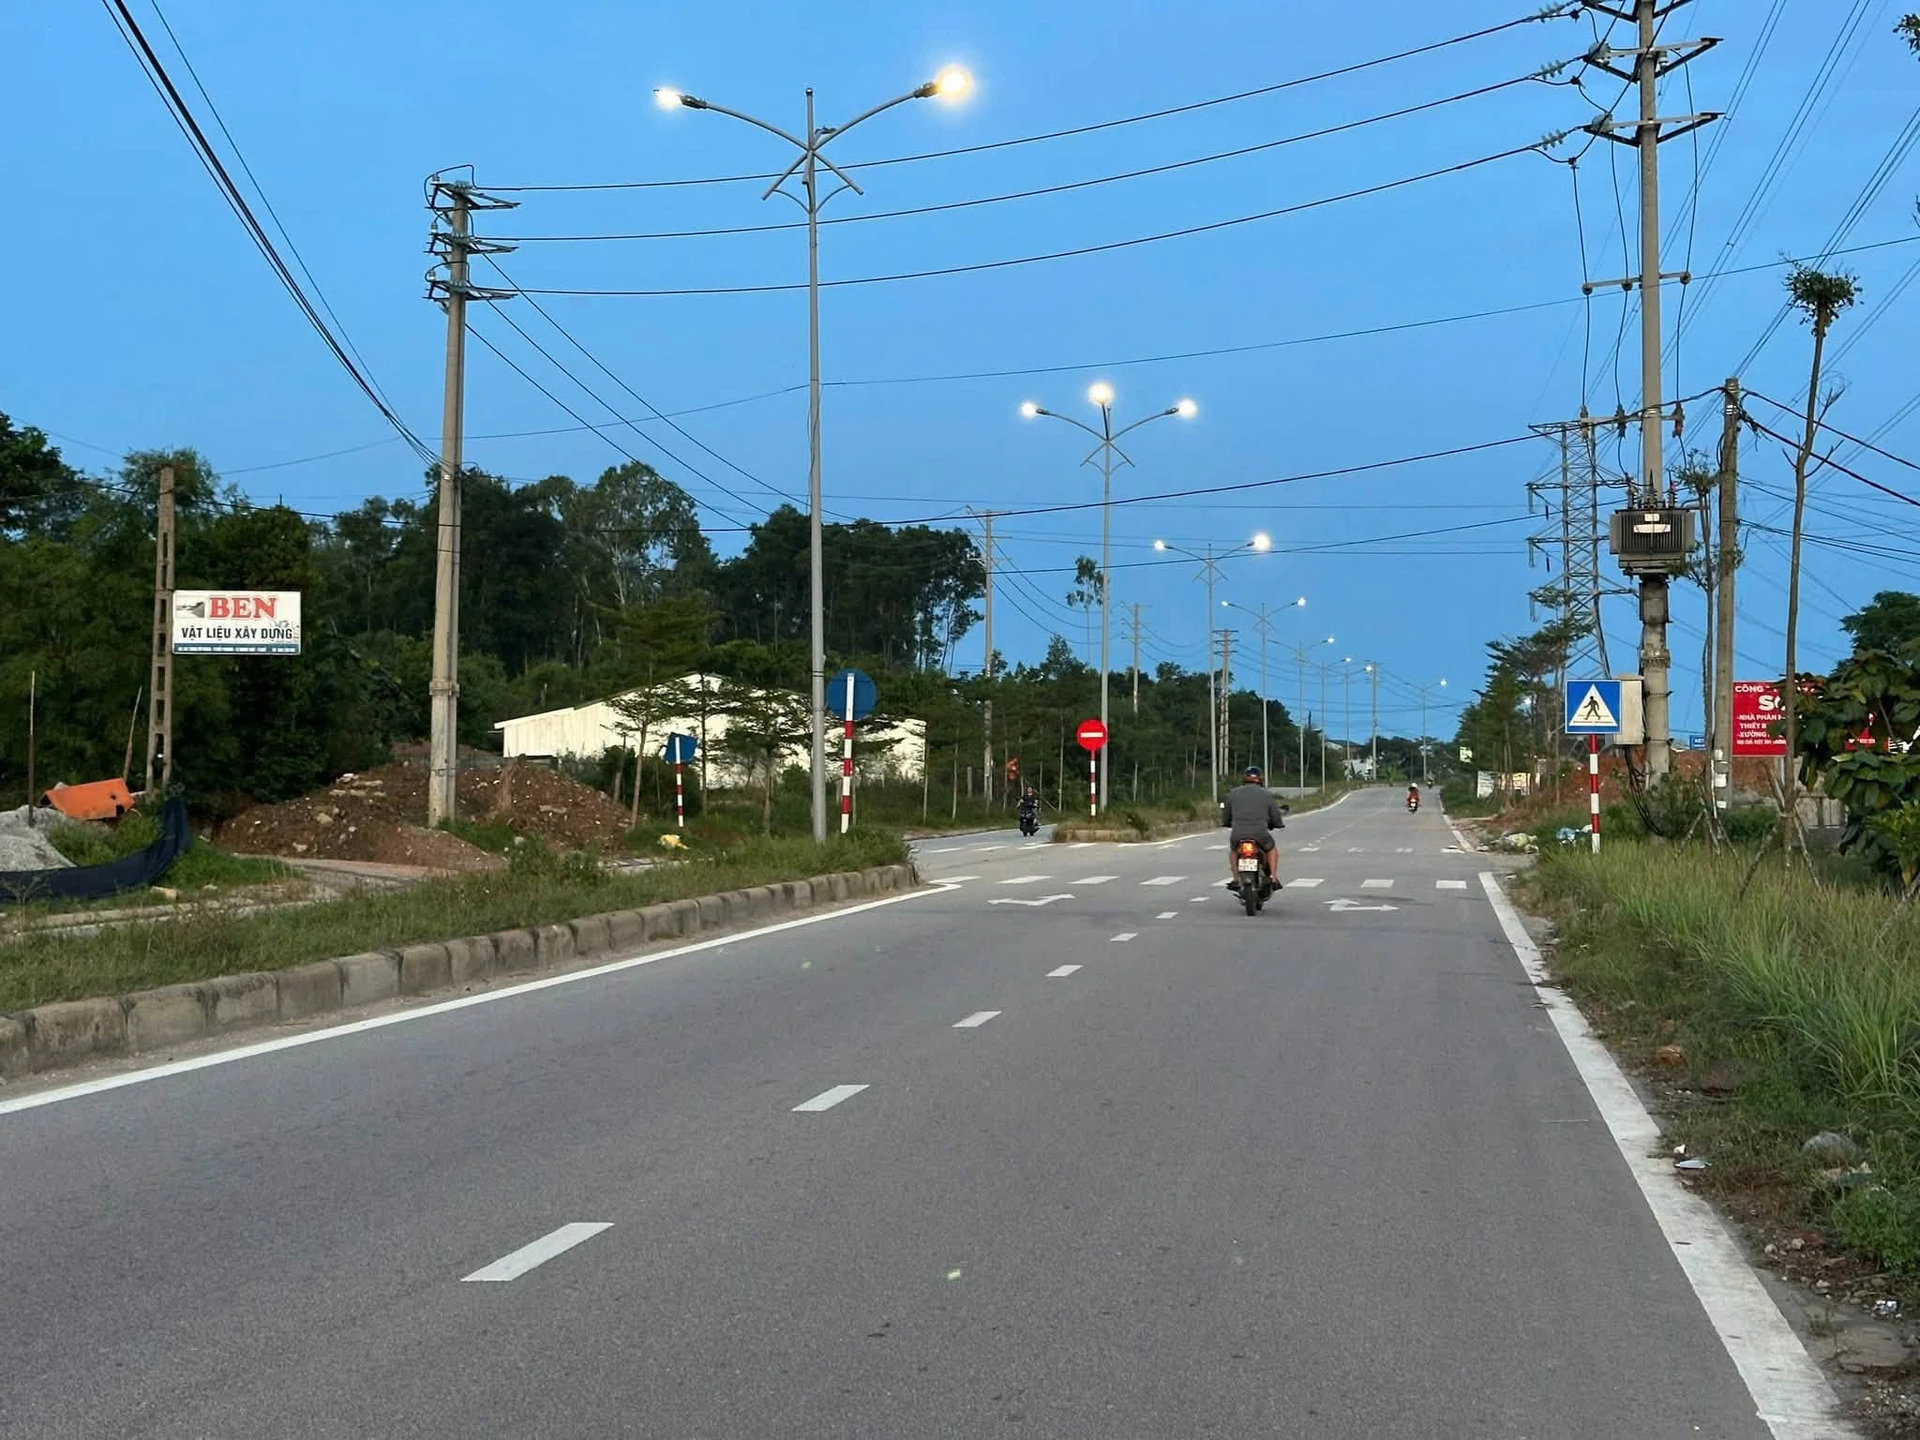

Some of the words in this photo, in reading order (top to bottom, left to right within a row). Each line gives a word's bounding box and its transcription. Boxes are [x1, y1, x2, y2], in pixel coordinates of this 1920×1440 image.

[209, 596, 277, 618] BEN
[181, 625, 203, 641] VẬT
[206, 625, 231, 641] LIỆU
[235, 625, 258, 640] XÂY
[1735, 684, 1764, 693] CÔNG
